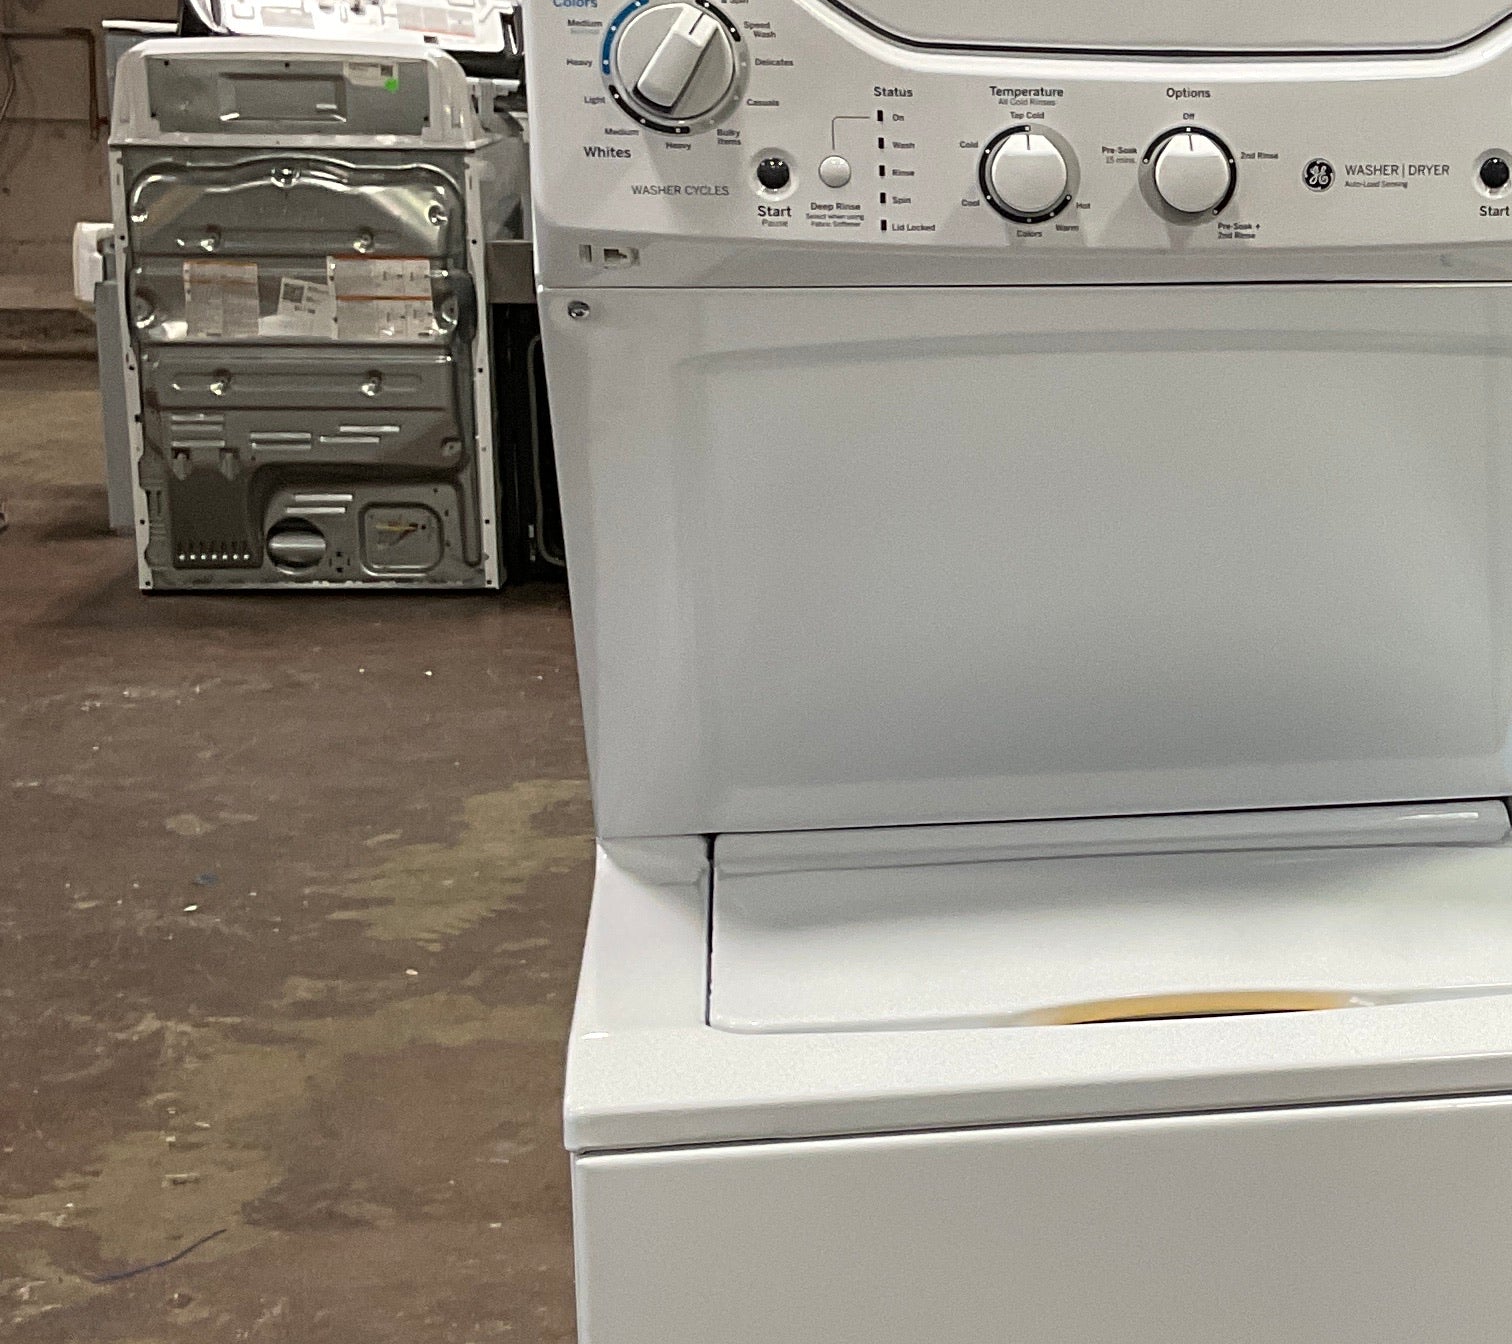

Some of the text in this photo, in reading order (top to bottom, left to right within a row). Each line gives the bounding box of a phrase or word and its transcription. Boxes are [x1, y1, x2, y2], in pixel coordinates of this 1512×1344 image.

[873, 86, 914, 98] Status
[989, 85, 1064, 99] Temperature
[1165, 87, 1211, 100] Options
[892, 113, 905, 122] On
[1010, 111, 1045, 121] Tap Cold
[1182, 112, 1195, 121] Off
[892, 141, 916, 150] Wash
[959, 140, 979, 149] Cold
[583, 145, 632, 159] Whites
[1240, 151, 1256, 160] 2nd
[1344, 164, 1450, 176] WASHER DRYER
[631, 184, 730, 196] WASHER CYCLES
[892, 196, 911, 205] Spin
[757, 205, 792, 218] Start
[810, 202, 861, 211] Deep Rinse
[1479, 205, 1510, 217] Start
[891, 222, 936, 232] Lid Locked
[1056, 223, 1080, 232] Warm
[1016, 229, 1043, 238] Colors
